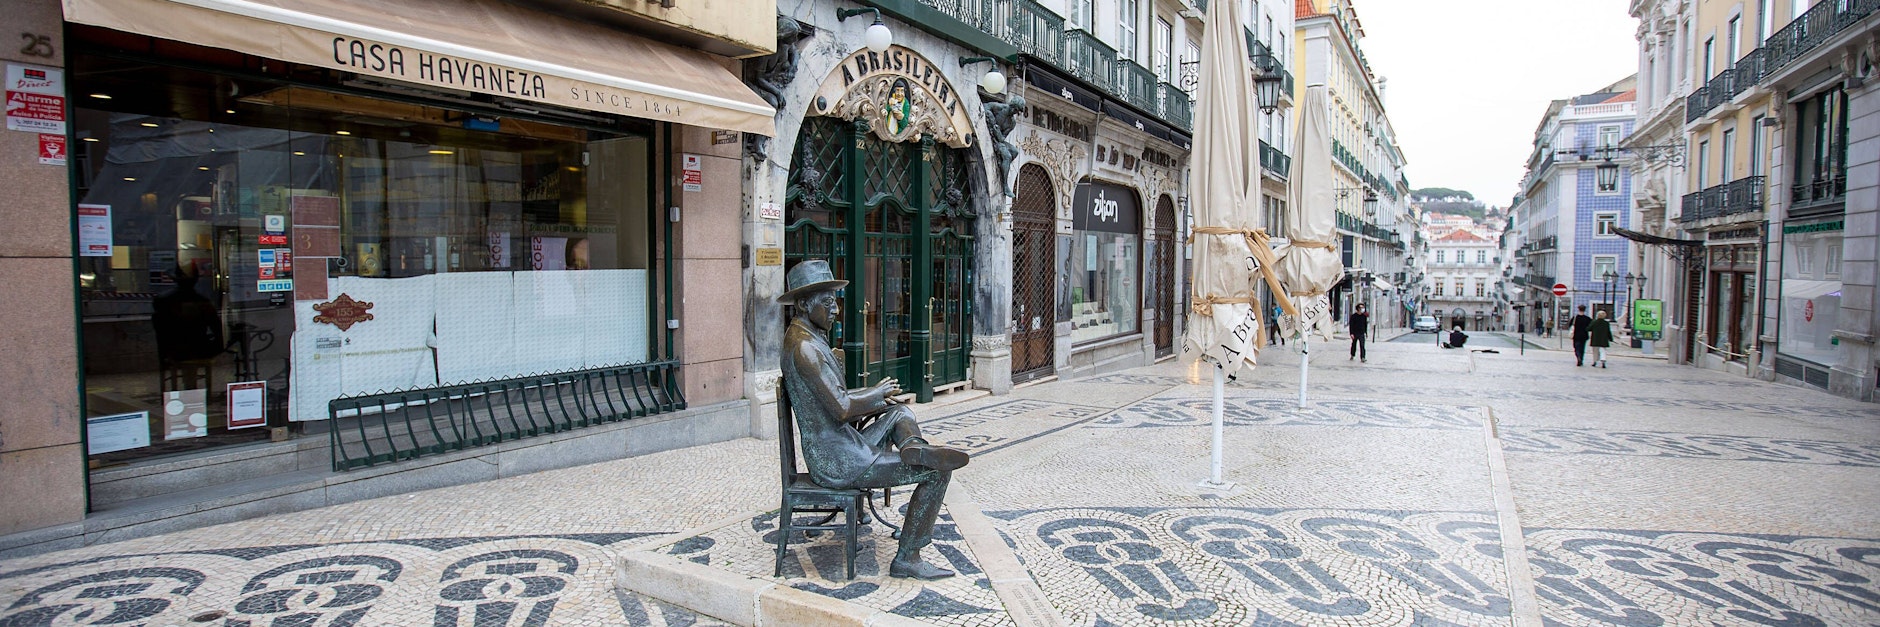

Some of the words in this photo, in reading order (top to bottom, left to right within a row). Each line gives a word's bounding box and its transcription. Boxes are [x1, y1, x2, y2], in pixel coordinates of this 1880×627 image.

[20, 32, 55, 59] 25
[332, 37, 405, 76] CASA
[418, 52, 546, 99] HAVANEZA
[841, 63, 855, 87] A
[854, 49, 957, 117] BRASILEIRA
[12, 92, 62, 105] Alarme
[570, 87, 633, 109] SINCE
[643, 99, 682, 117] 1864
[1304, 295, 1328, 320] Bra
[1221, 344, 1241, 364] A
